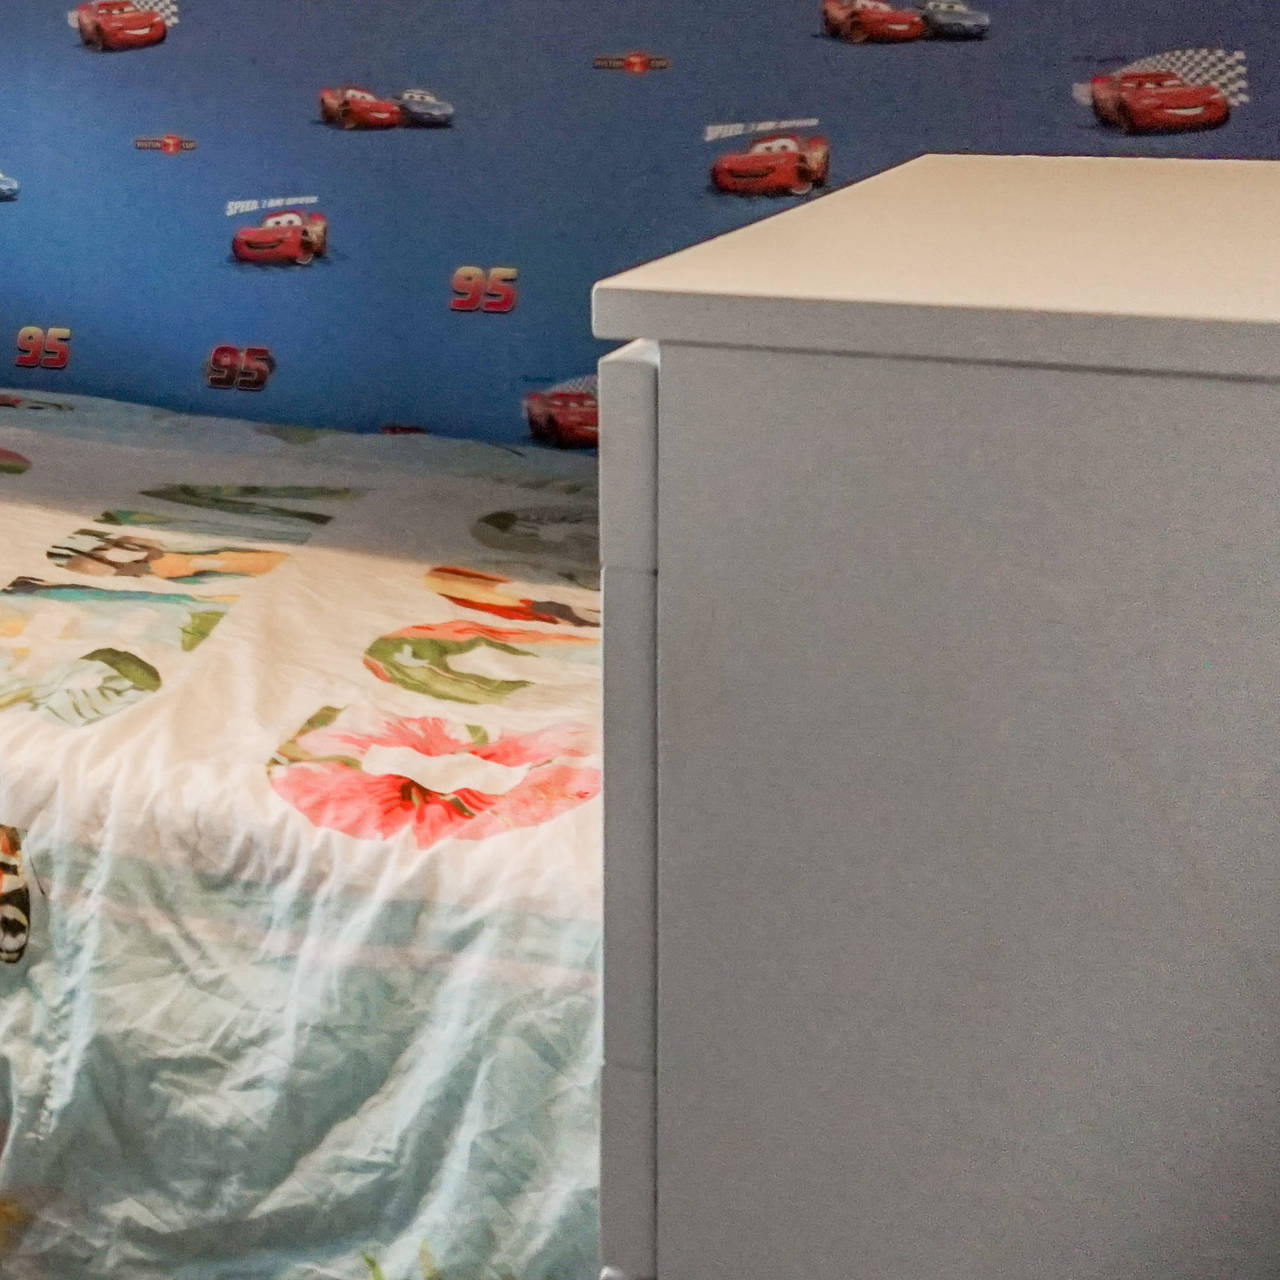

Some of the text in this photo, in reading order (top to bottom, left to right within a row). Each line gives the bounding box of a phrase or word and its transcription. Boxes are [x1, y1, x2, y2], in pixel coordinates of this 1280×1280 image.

[450, 266, 518, 314] 95
[15, 326, 71, 369] 95
[207, 345, 272, 390] 95
